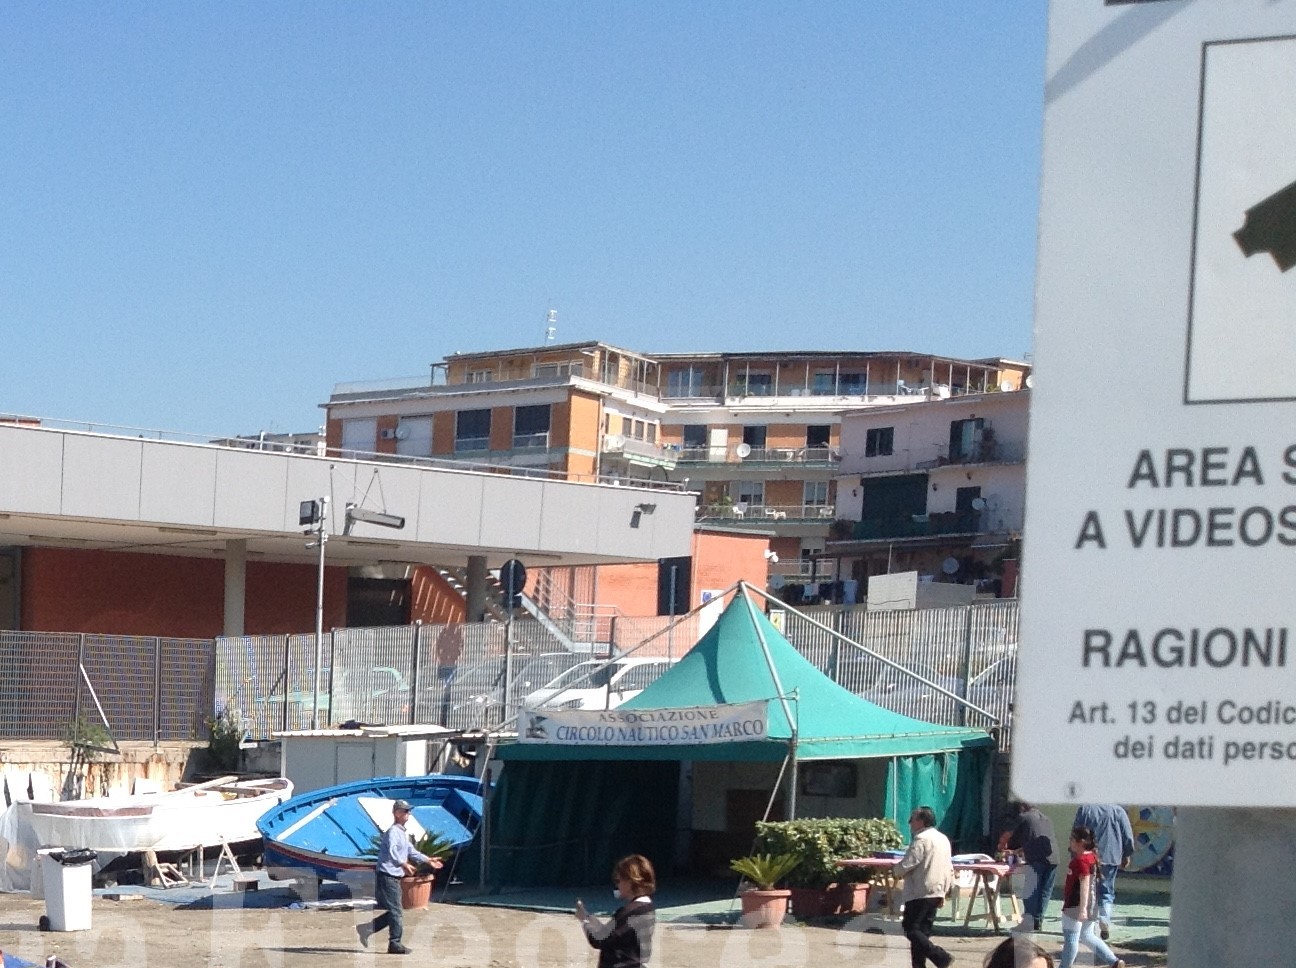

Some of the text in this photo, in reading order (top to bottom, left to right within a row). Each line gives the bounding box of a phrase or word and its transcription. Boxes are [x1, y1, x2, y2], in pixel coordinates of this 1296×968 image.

[1127, 446, 1264, 488] AREA
[1074, 510, 1107, 549] A
[1081, 627, 1288, 668] RAGIONI
[599, 710, 719, 723] ASSOCIAZIONE
[1067, 700, 1296, 724] Art. 13 del Codic
[556, 719, 764, 742] CIRCOLO NAUTICO SAN MARCO
[1114, 736, 1154, 759] dei
[1163, 736, 1214, 759] dati
